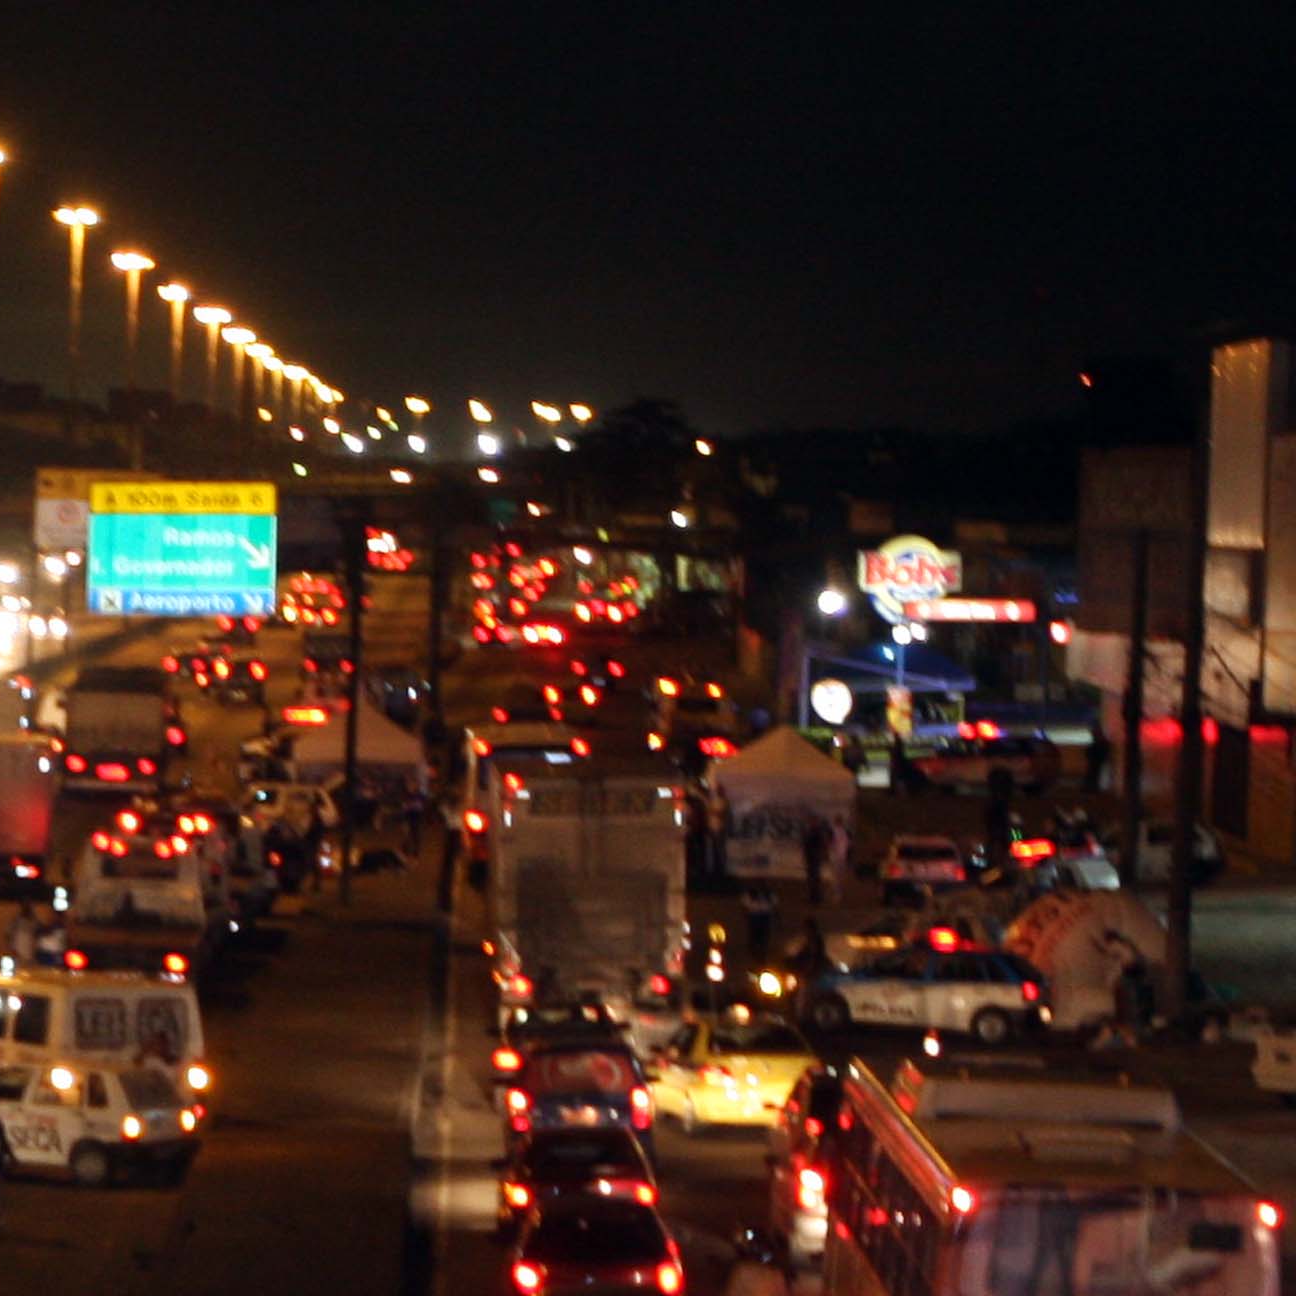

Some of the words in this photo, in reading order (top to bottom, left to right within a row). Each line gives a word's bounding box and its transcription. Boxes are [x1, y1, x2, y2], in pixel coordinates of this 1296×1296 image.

[163, 526, 236, 547] Ramos
[112, 555, 235, 578] Governador
[130, 590, 237, 611] Aeroporto
